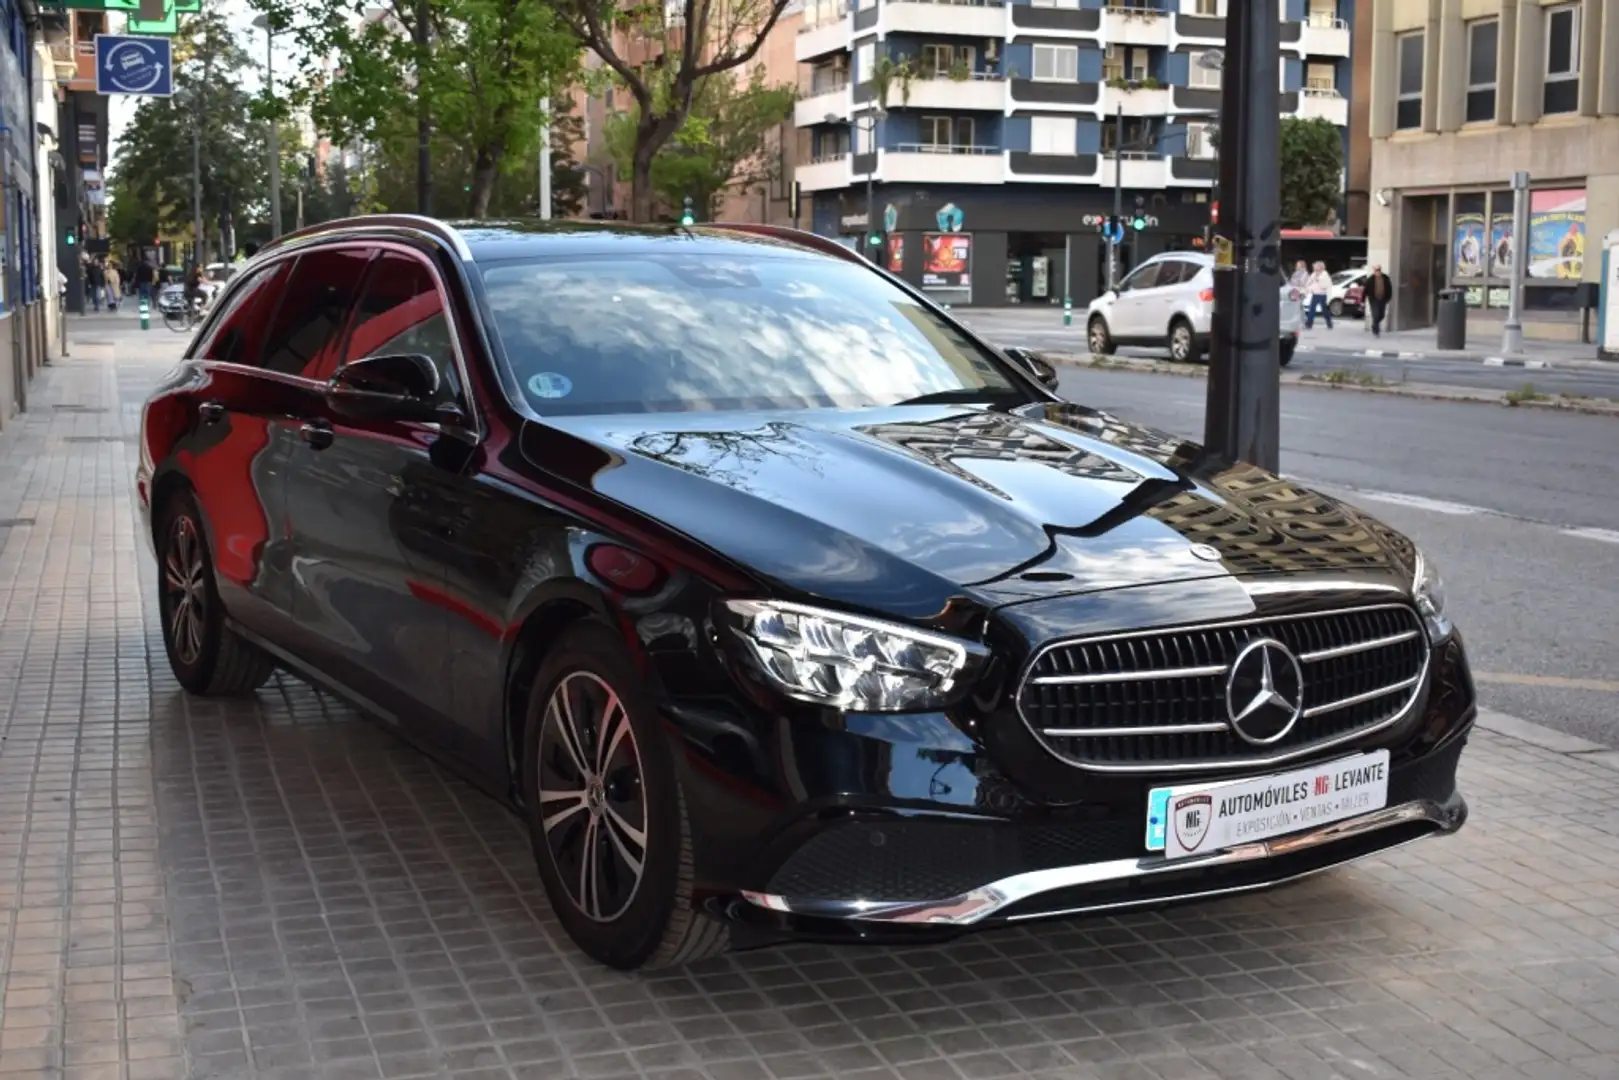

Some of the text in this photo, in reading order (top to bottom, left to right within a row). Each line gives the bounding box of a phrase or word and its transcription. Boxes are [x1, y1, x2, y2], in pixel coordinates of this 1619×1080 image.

[1218, 781, 1308, 818] AUTOMÓVILES
[1335, 762, 1384, 791] LEVANTE
[1236, 809, 1290, 838] EXPOSICIÓN
